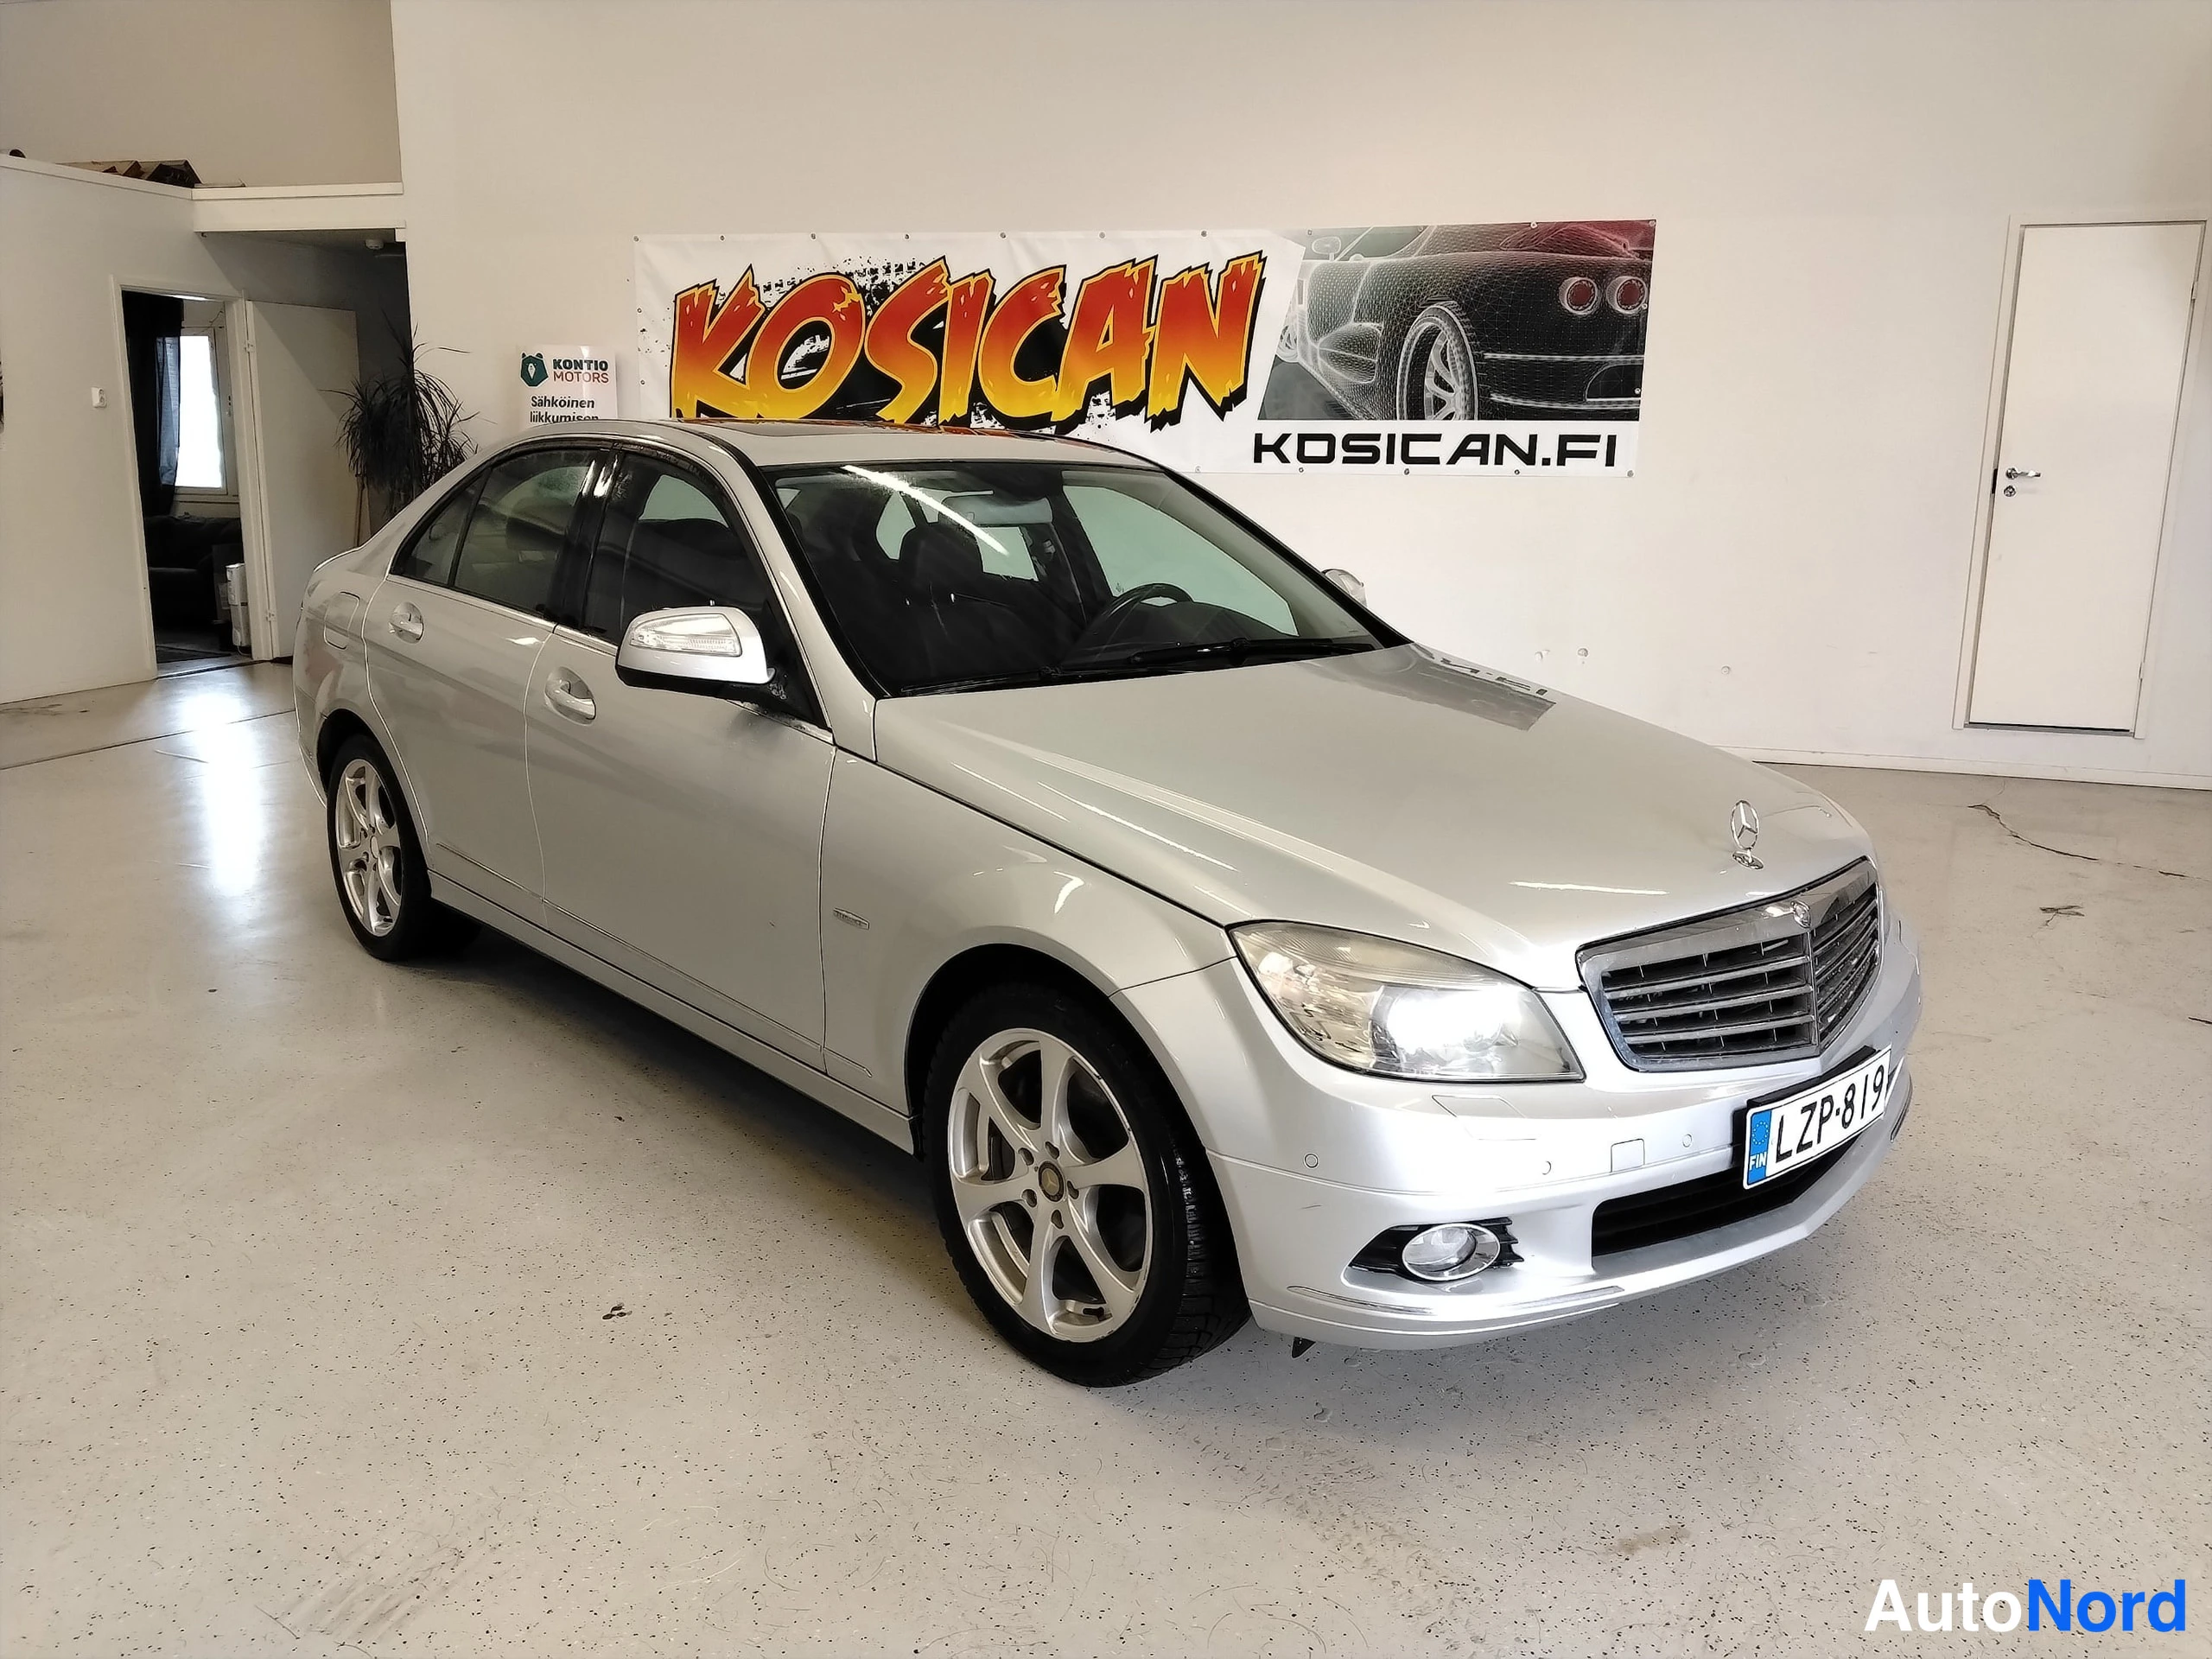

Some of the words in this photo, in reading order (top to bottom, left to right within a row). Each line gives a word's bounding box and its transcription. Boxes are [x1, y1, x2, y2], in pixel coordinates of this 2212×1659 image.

[669, 251, 1268, 432] KOSICAN
[552, 359, 608, 372] KONTIO
[553, 372, 609, 384] MOTORS
[531, 395, 595, 409] Sähköinen
[1253, 433, 1618, 468] KOSICAN.FI
[1775, 1064, 1885, 1164] LZP-819
[1748, 1151, 1768, 1172] FIN
